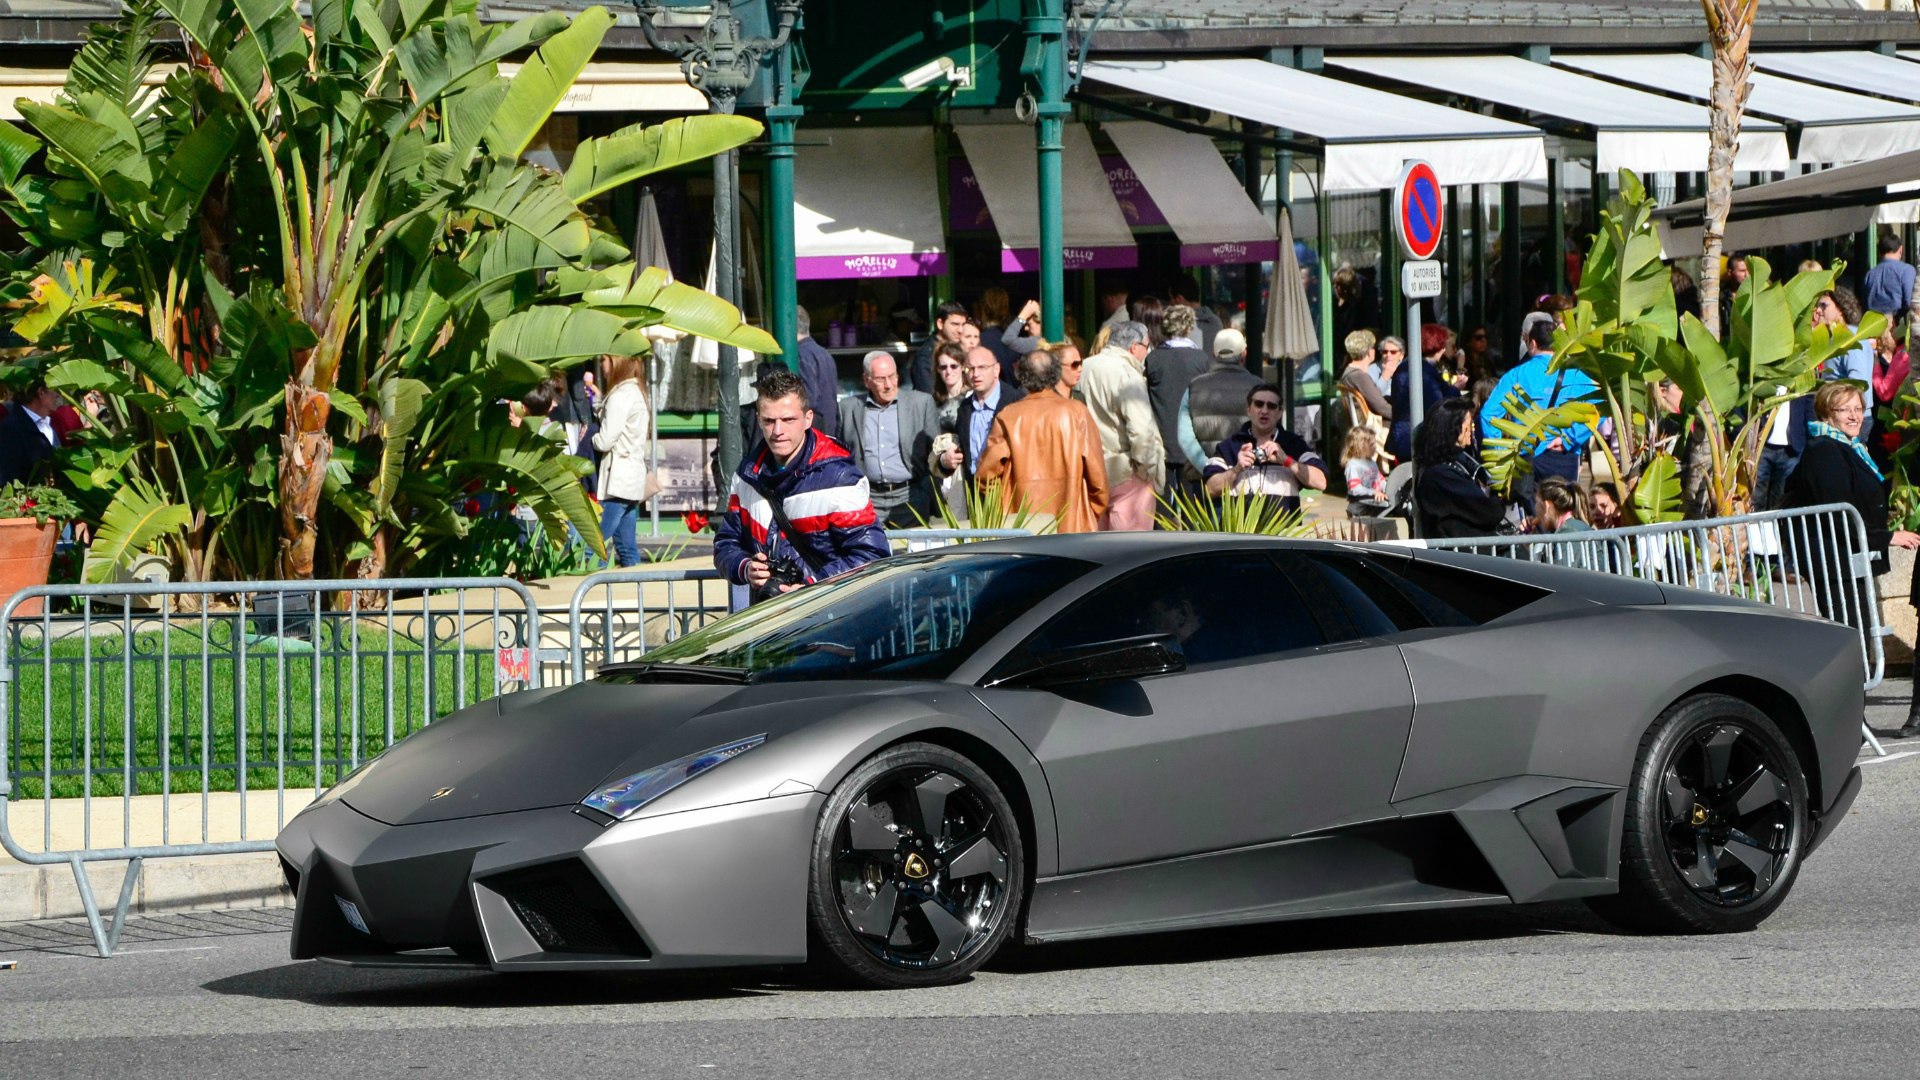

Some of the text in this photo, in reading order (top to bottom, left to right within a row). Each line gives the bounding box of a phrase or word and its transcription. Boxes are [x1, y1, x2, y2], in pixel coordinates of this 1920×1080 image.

[561, 84, 594, 108] hopard
[1063, 248, 1094, 261] RELLI'S
[844, 255, 897, 270] MORELLI'S
[1418, 280, 1440, 291] MINUTES
